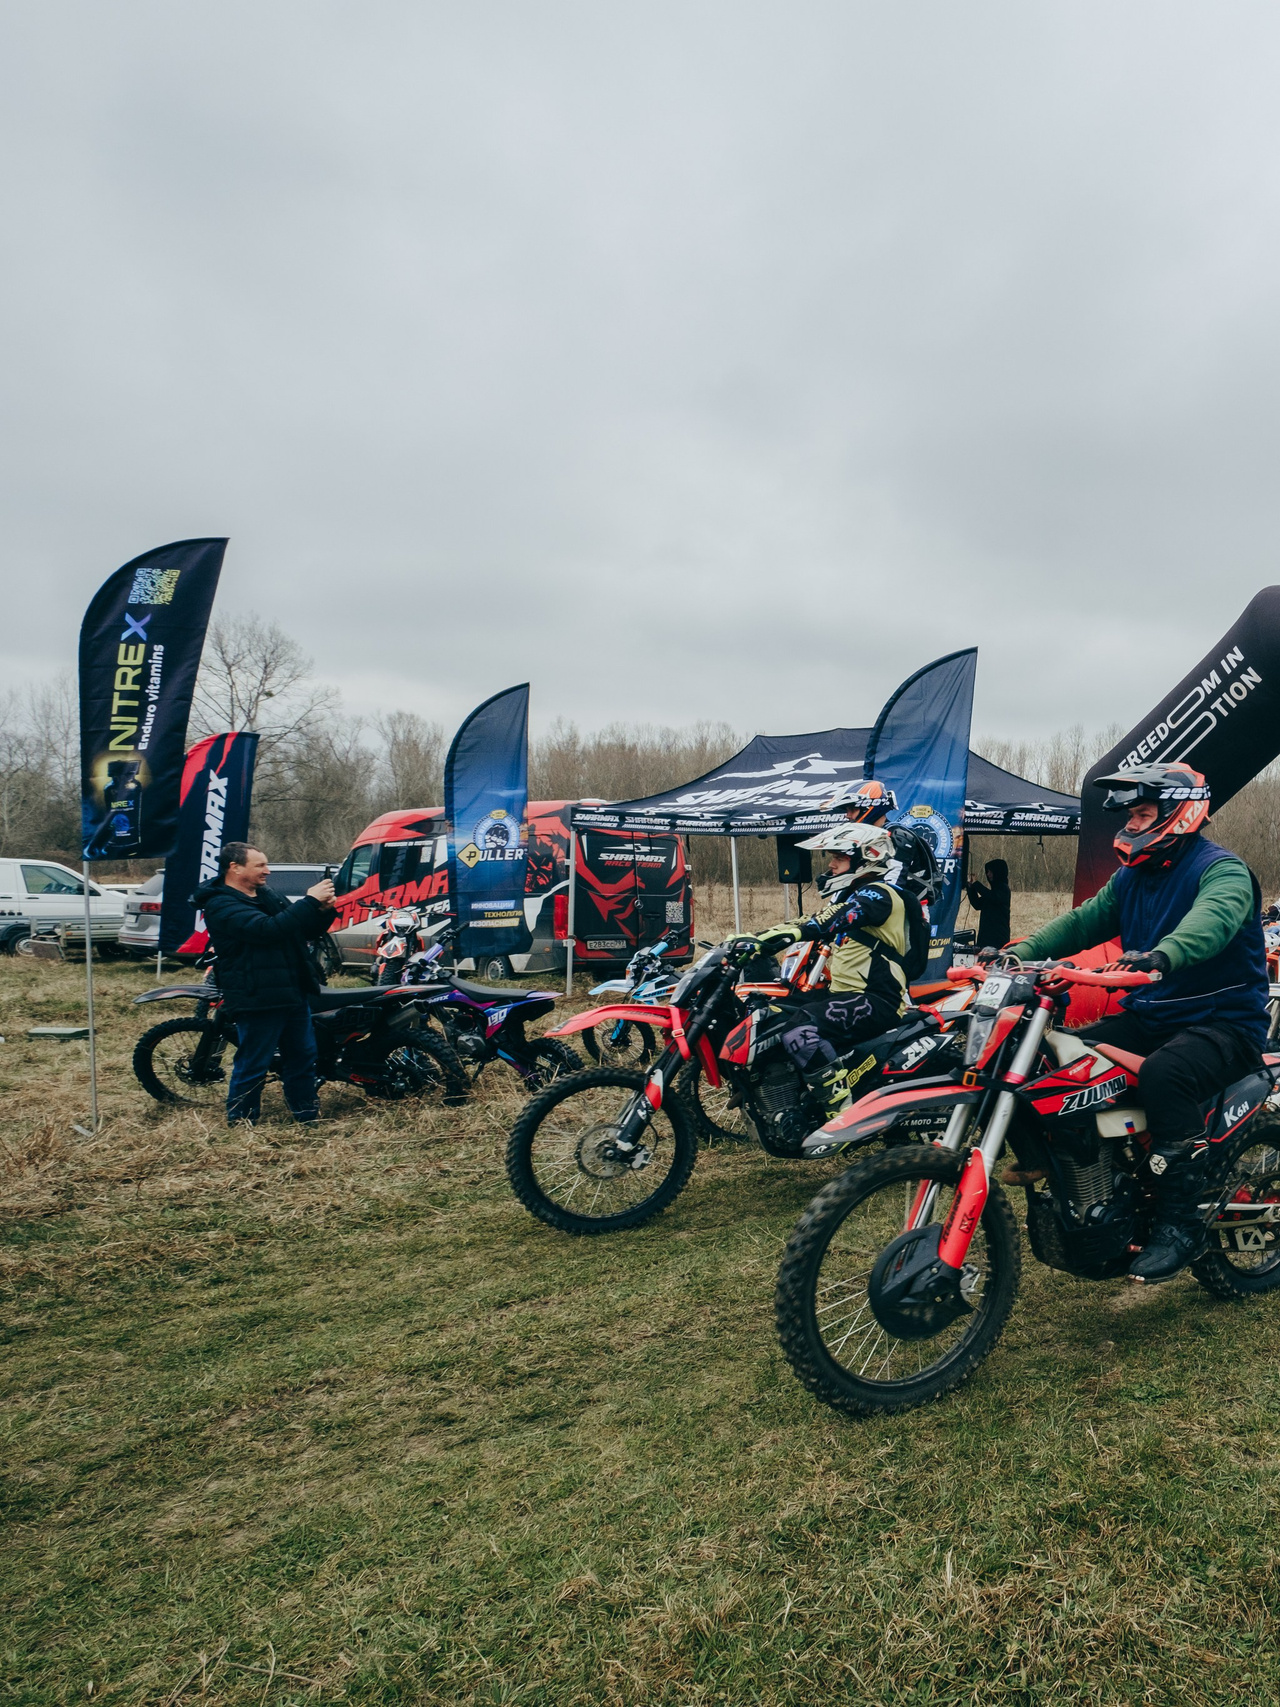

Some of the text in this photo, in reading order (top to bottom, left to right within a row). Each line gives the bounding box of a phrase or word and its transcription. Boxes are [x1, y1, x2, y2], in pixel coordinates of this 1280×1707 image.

[109, 612, 151, 751] NITREX
[138, 643, 164, 751] Enduro vitamins
[1117, 645, 1245, 771] FREEDOM IN
[1152, 666, 1263, 763] OTION
[659, 779, 865, 806] SHARMA
[855, 798, 890, 807] 100%
[573, 813, 620, 823] SHARMAX
[625, 816, 671, 826] SHARMAX
[675, 819, 723, 827] SHARMAX
[1011, 812, 1071, 824] SHARMAX
[598, 853, 668, 863] SHARMAX
[425, 899, 451, 915] TEA
[1058, 1073, 1128, 1116] ZUUMAV
[911, 1118, 932, 1126] MOTO
